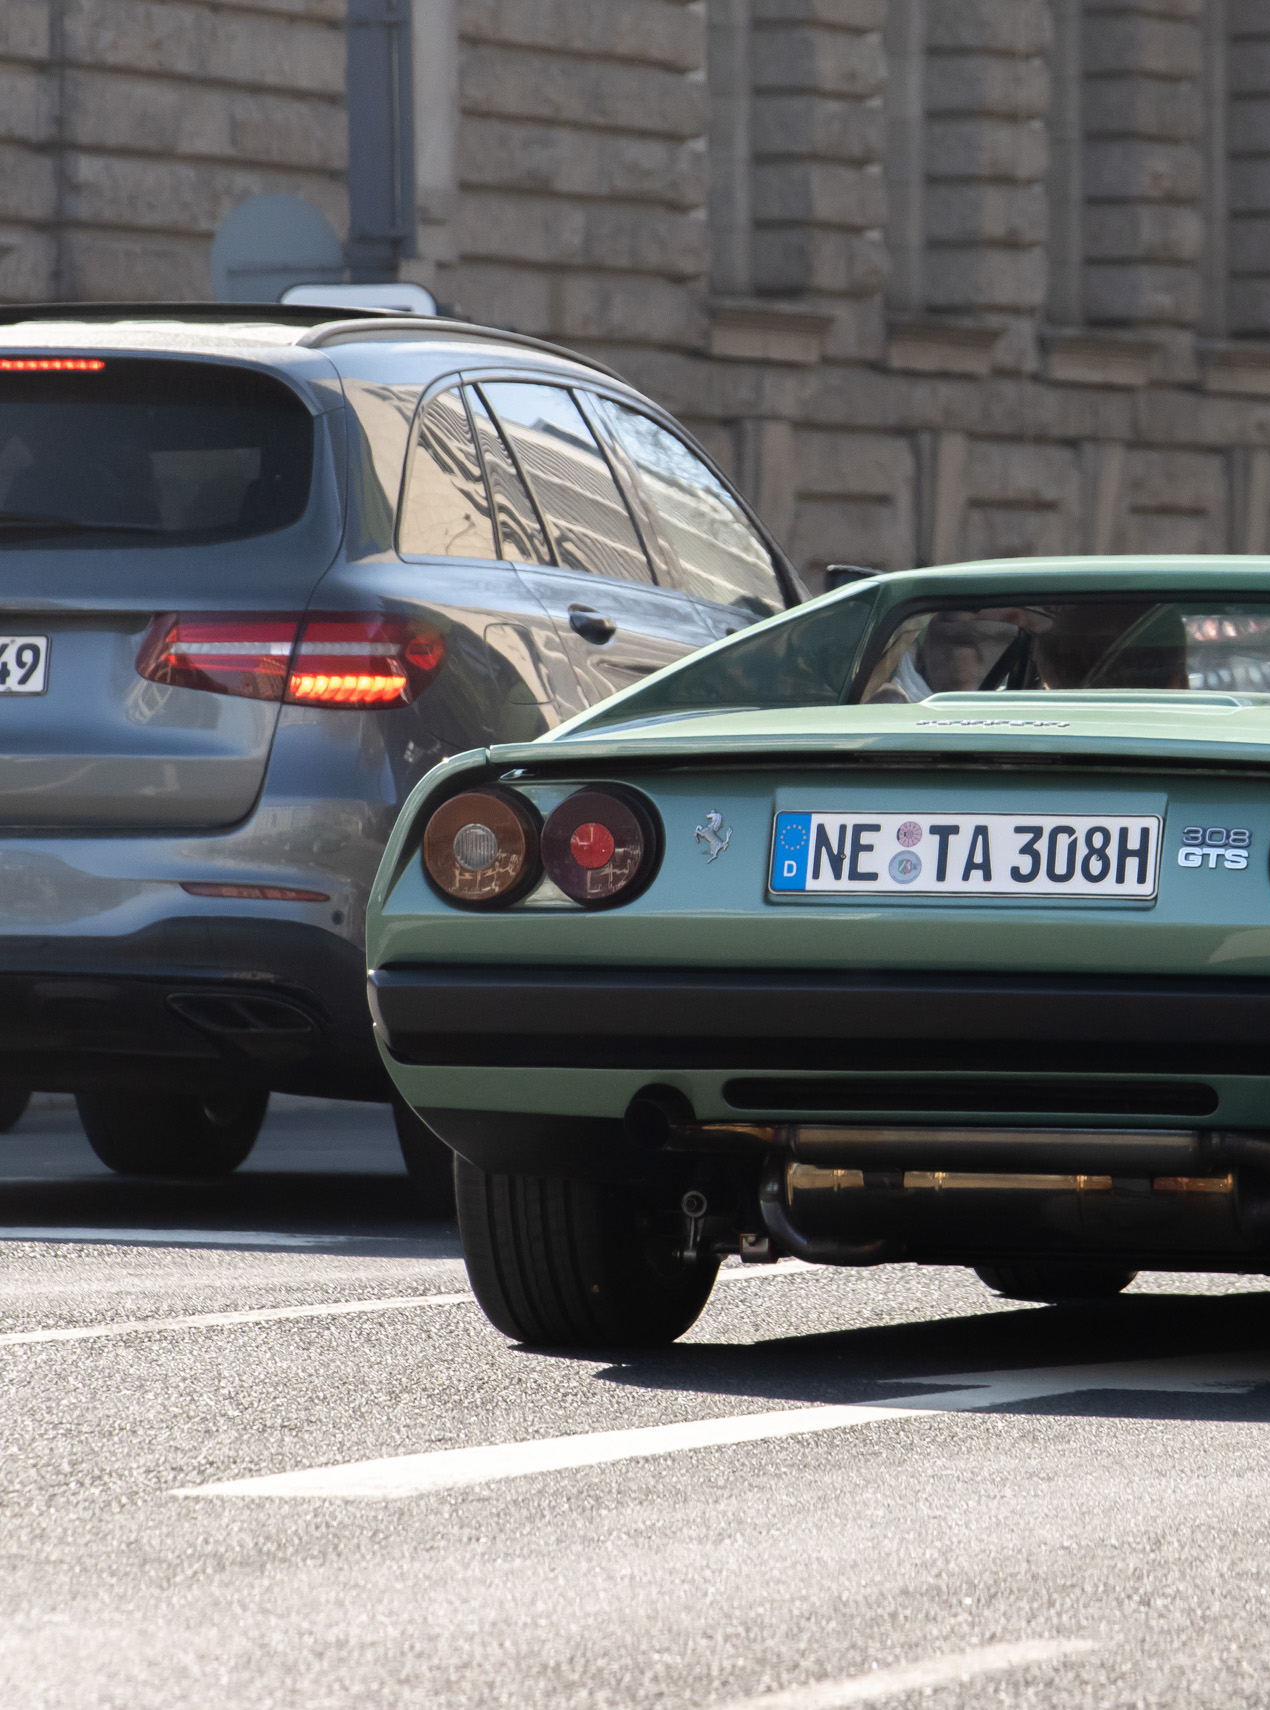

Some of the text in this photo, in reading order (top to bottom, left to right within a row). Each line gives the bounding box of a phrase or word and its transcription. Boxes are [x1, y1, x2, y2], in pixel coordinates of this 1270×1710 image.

[1181, 826, 1253, 848] 308
[811, 823, 1151, 884] NE TA 308H
[1177, 847, 1250, 869] GTS
[783, 860, 798, 878] D
